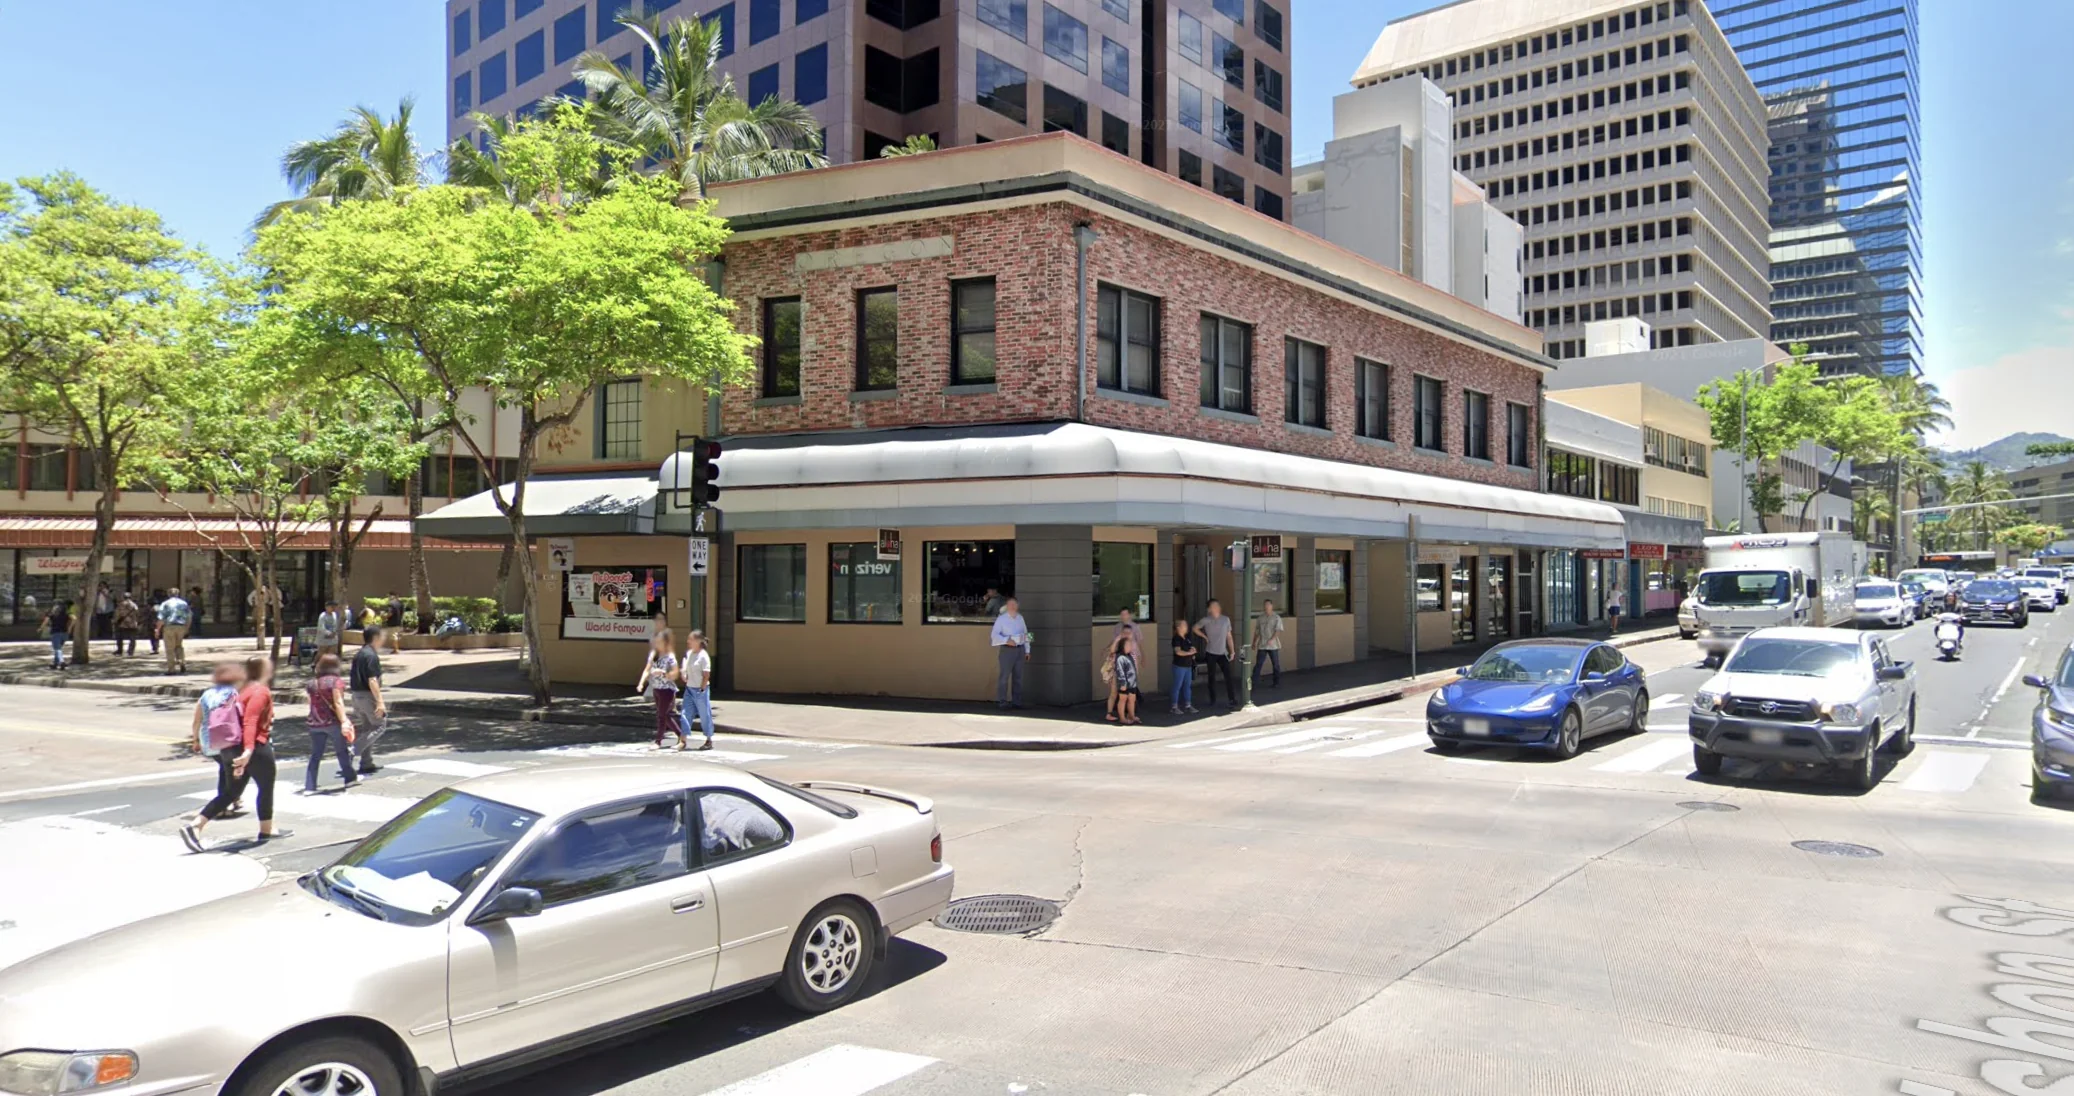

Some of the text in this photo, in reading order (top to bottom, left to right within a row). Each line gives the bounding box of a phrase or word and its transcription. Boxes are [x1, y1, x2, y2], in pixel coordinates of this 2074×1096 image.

[797, 236, 951, 269] OREGON
[692, 541, 707, 551] ONE
[692, 551, 707, 561] WAY
[585, 621, 646, 636] World Famous
